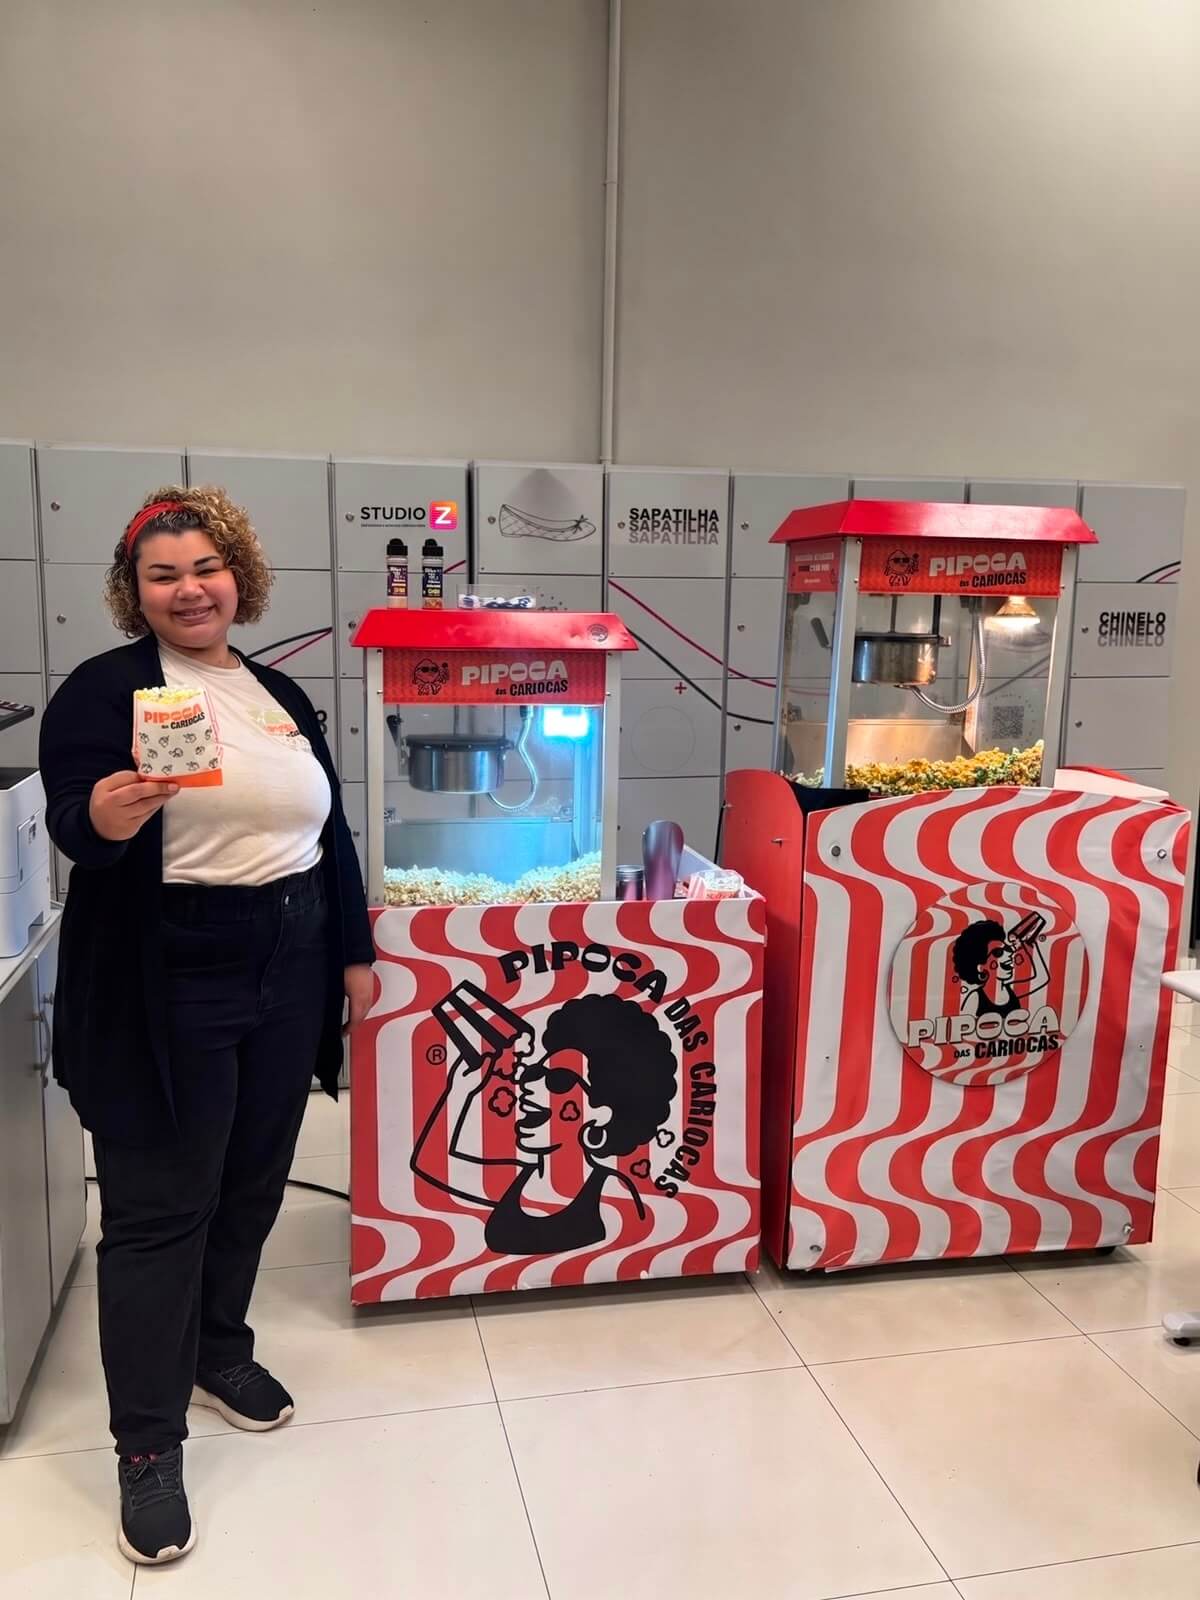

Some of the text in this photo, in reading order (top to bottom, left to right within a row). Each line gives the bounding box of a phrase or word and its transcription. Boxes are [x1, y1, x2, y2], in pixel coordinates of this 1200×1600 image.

[360, 506, 452, 525] STUDIO Z
[629, 508, 719, 522] SAPATILHA
[629, 520, 719, 533] SAPATILHA
[628, 532, 719, 544] SAPATILHA
[929, 551, 1027, 577] PIPOCA
[972, 571, 1026, 588] CARIOCAS
[1099, 612, 1166, 624] CHINELO
[1098, 623, 1165, 636] CHINELO
[1097, 635, 1164, 647] CHINELO
[461, 660, 568, 686] PIPOCA
[510, 679, 568, 696] CARIOCAS
[144, 703, 201, 724] PIPOCA
[908, 1005, 1060, 1047] PIPOCA
[953, 1034, 1059, 1059] DAS CARIOCAS
[497, 941, 717, 1198] PIPOCA DAS CARIOCAS
